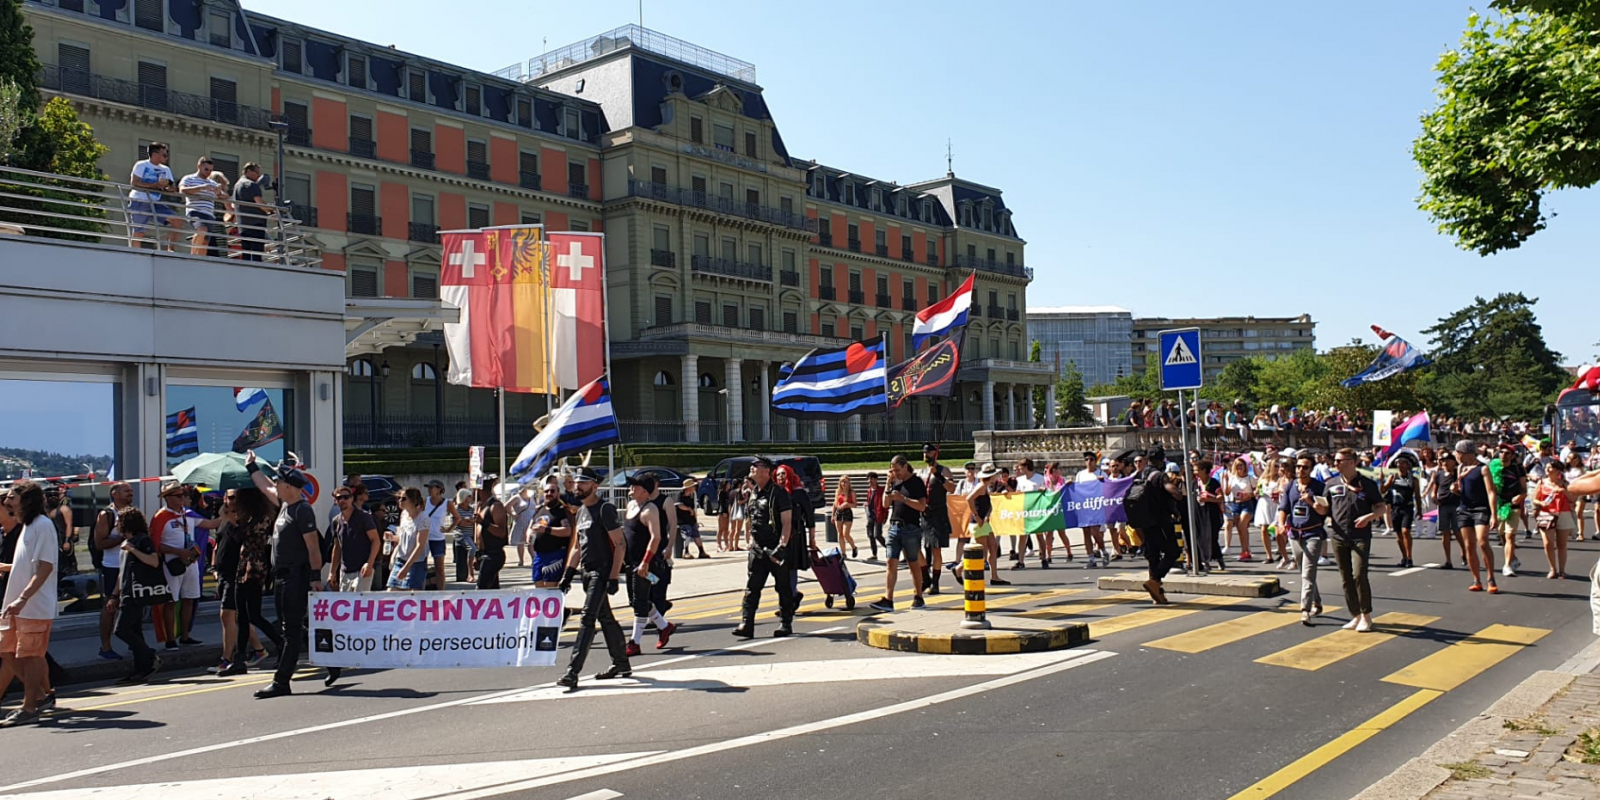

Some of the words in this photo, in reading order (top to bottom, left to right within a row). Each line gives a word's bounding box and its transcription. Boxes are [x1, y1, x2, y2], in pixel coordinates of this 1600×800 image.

[1000, 509, 1013, 520] Be
[1015, 502, 1064, 520] yoursf.
[1067, 501, 1082, 511] Be
[313, 597, 561, 621] #CHECHNYA100
[334, 633, 376, 655] Stop
[382, 634, 412, 651] the
[419, 631, 534, 655] persecution!
